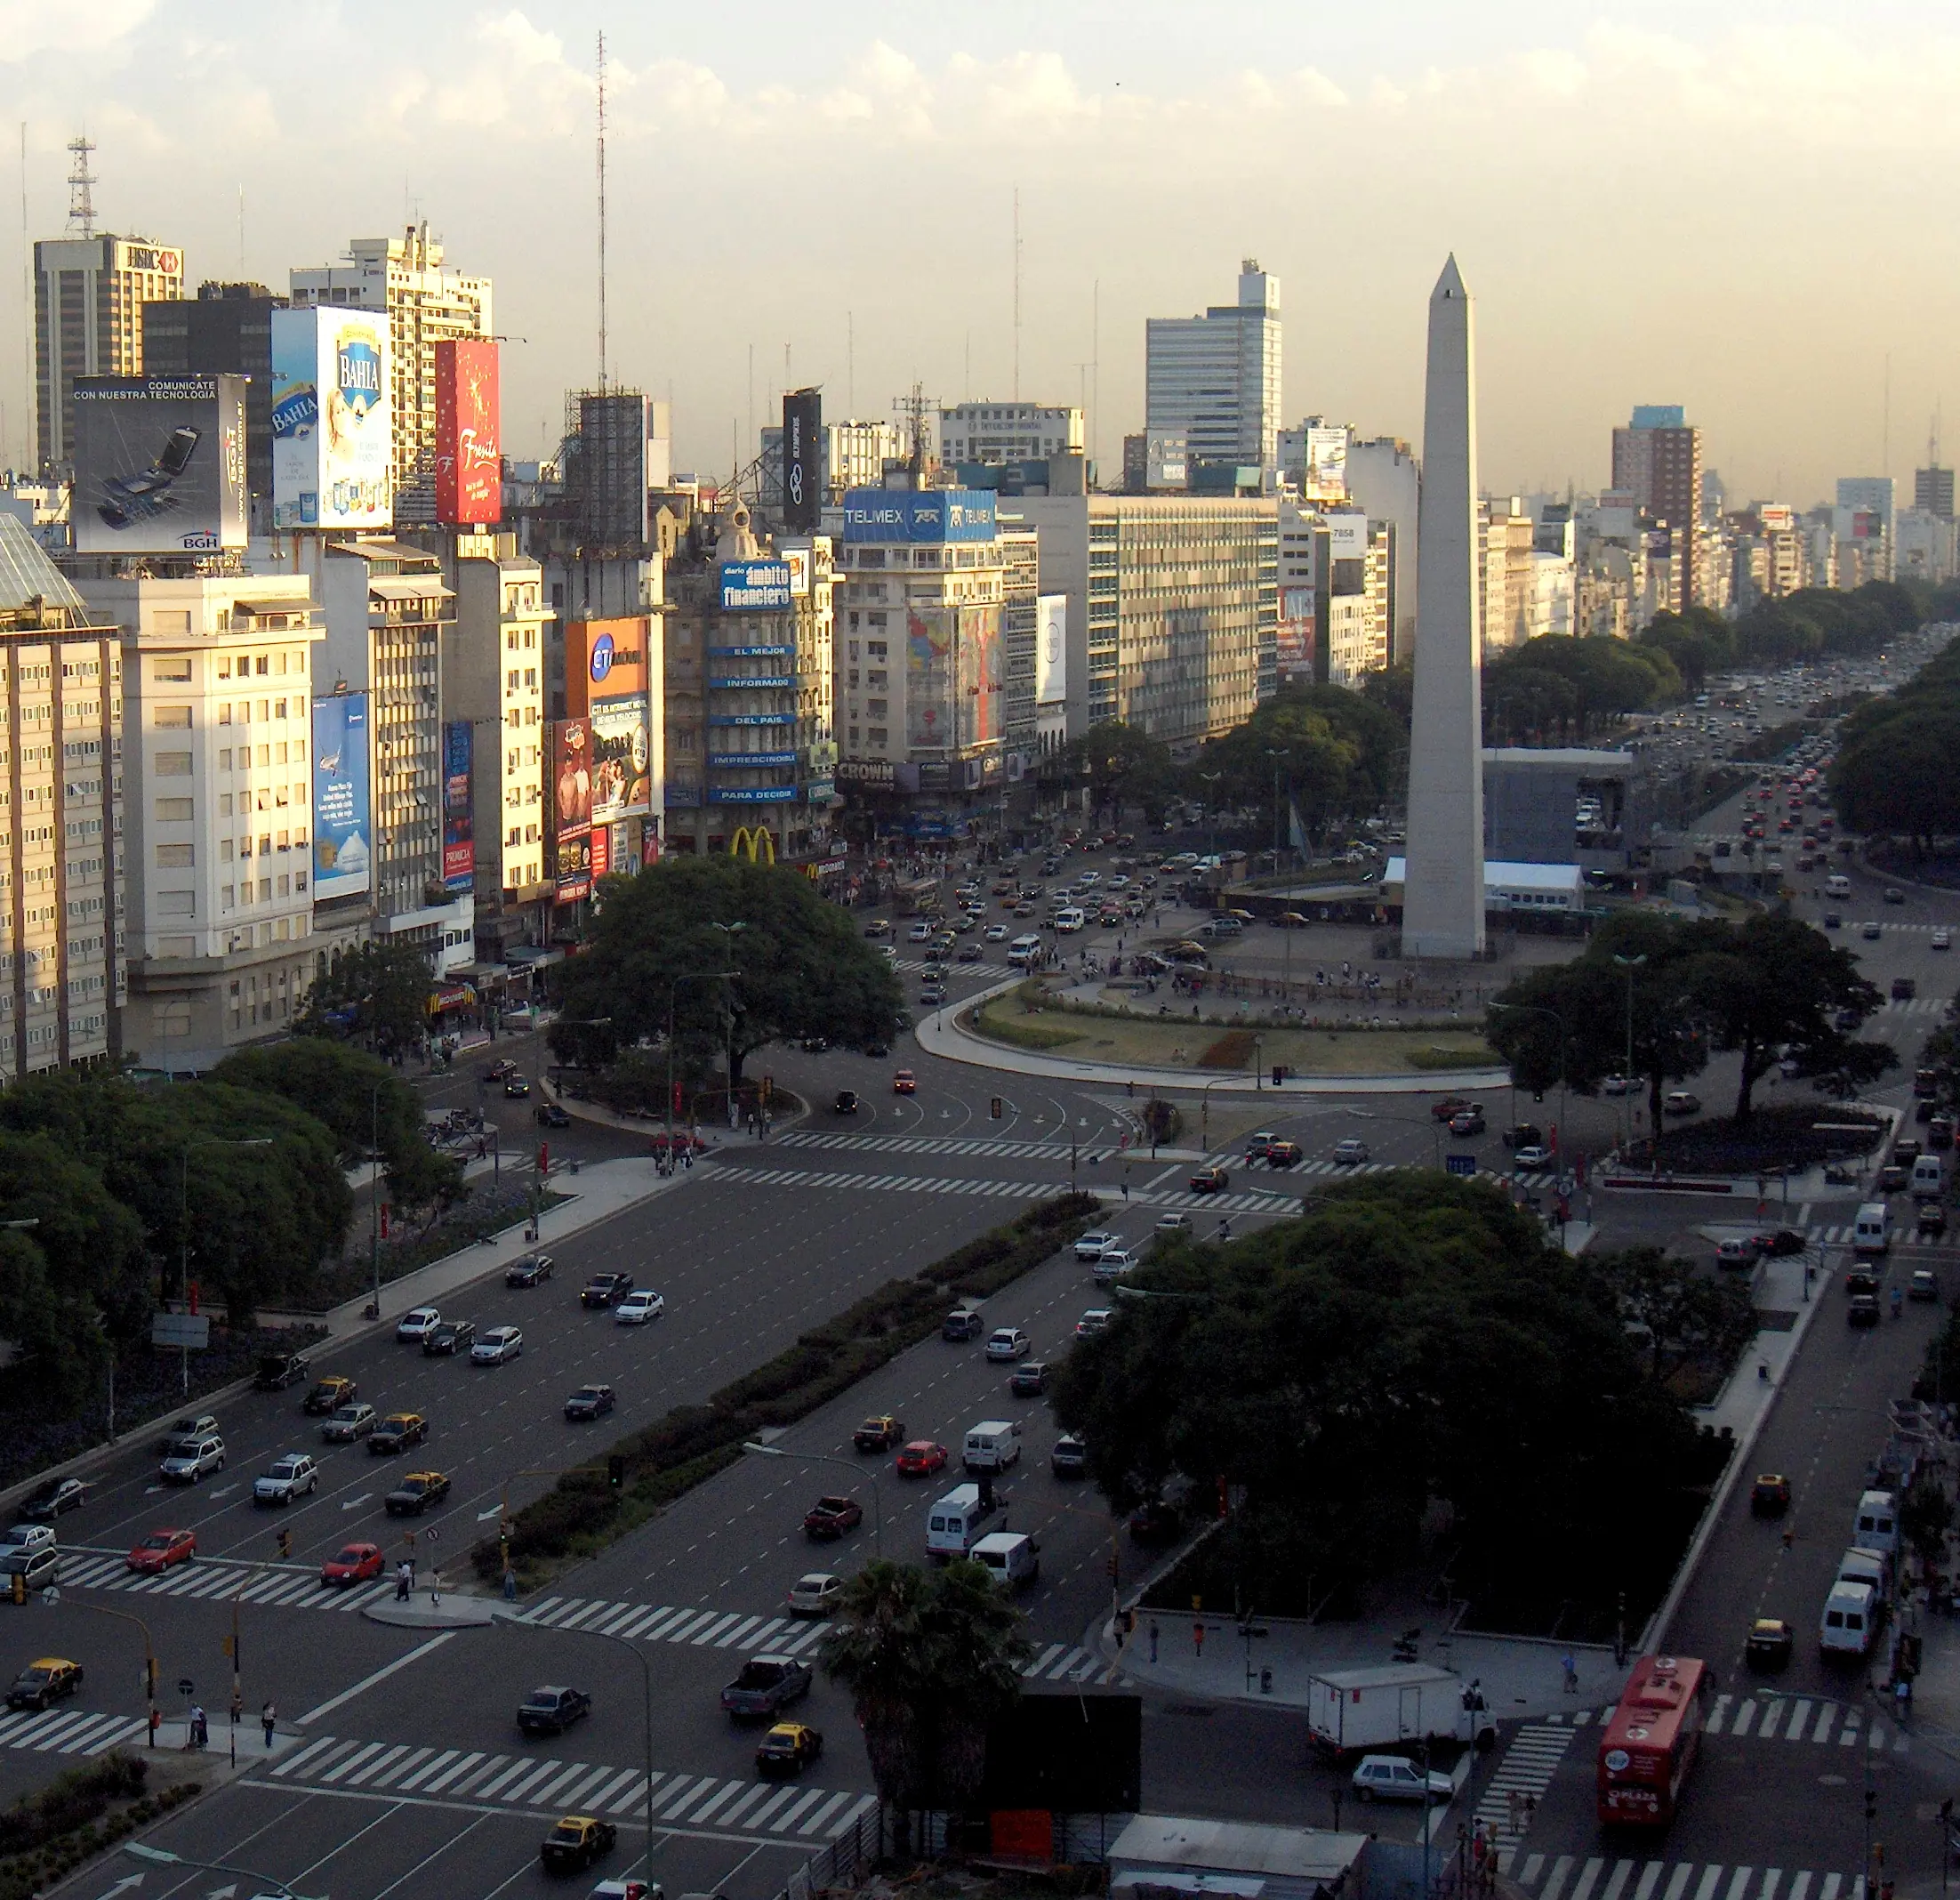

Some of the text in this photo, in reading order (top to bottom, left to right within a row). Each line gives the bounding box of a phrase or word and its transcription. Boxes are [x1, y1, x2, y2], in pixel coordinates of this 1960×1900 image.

[127, 246, 159, 270] HSBC
[340, 354, 379, 390] BAHIA
[149, 381, 215, 390] COMUNICATE
[74, 390, 216, 400] CON NUESTRA TECNOLOGIA
[271, 397, 318, 432] BAHIA
[229, 429, 237, 482] BGH
[237, 400, 245, 523] www.bgh.com.ar
[846, 509, 904, 524] TELMEX
[964, 509, 991, 523] TELMEX
[183, 538, 217, 549] BGH
[725, 565, 789, 586] diario ámbito
[724, 586, 790, 607] financiero
[734, 647, 785, 656] EL MEJOR
[727, 679, 789, 687] INFORMADO
[714, 754, 795, 765] IMPRESCINDIBLE
[838, 763, 894, 780] CROWN
[721, 790, 791, 800] PARA DECIDIR
